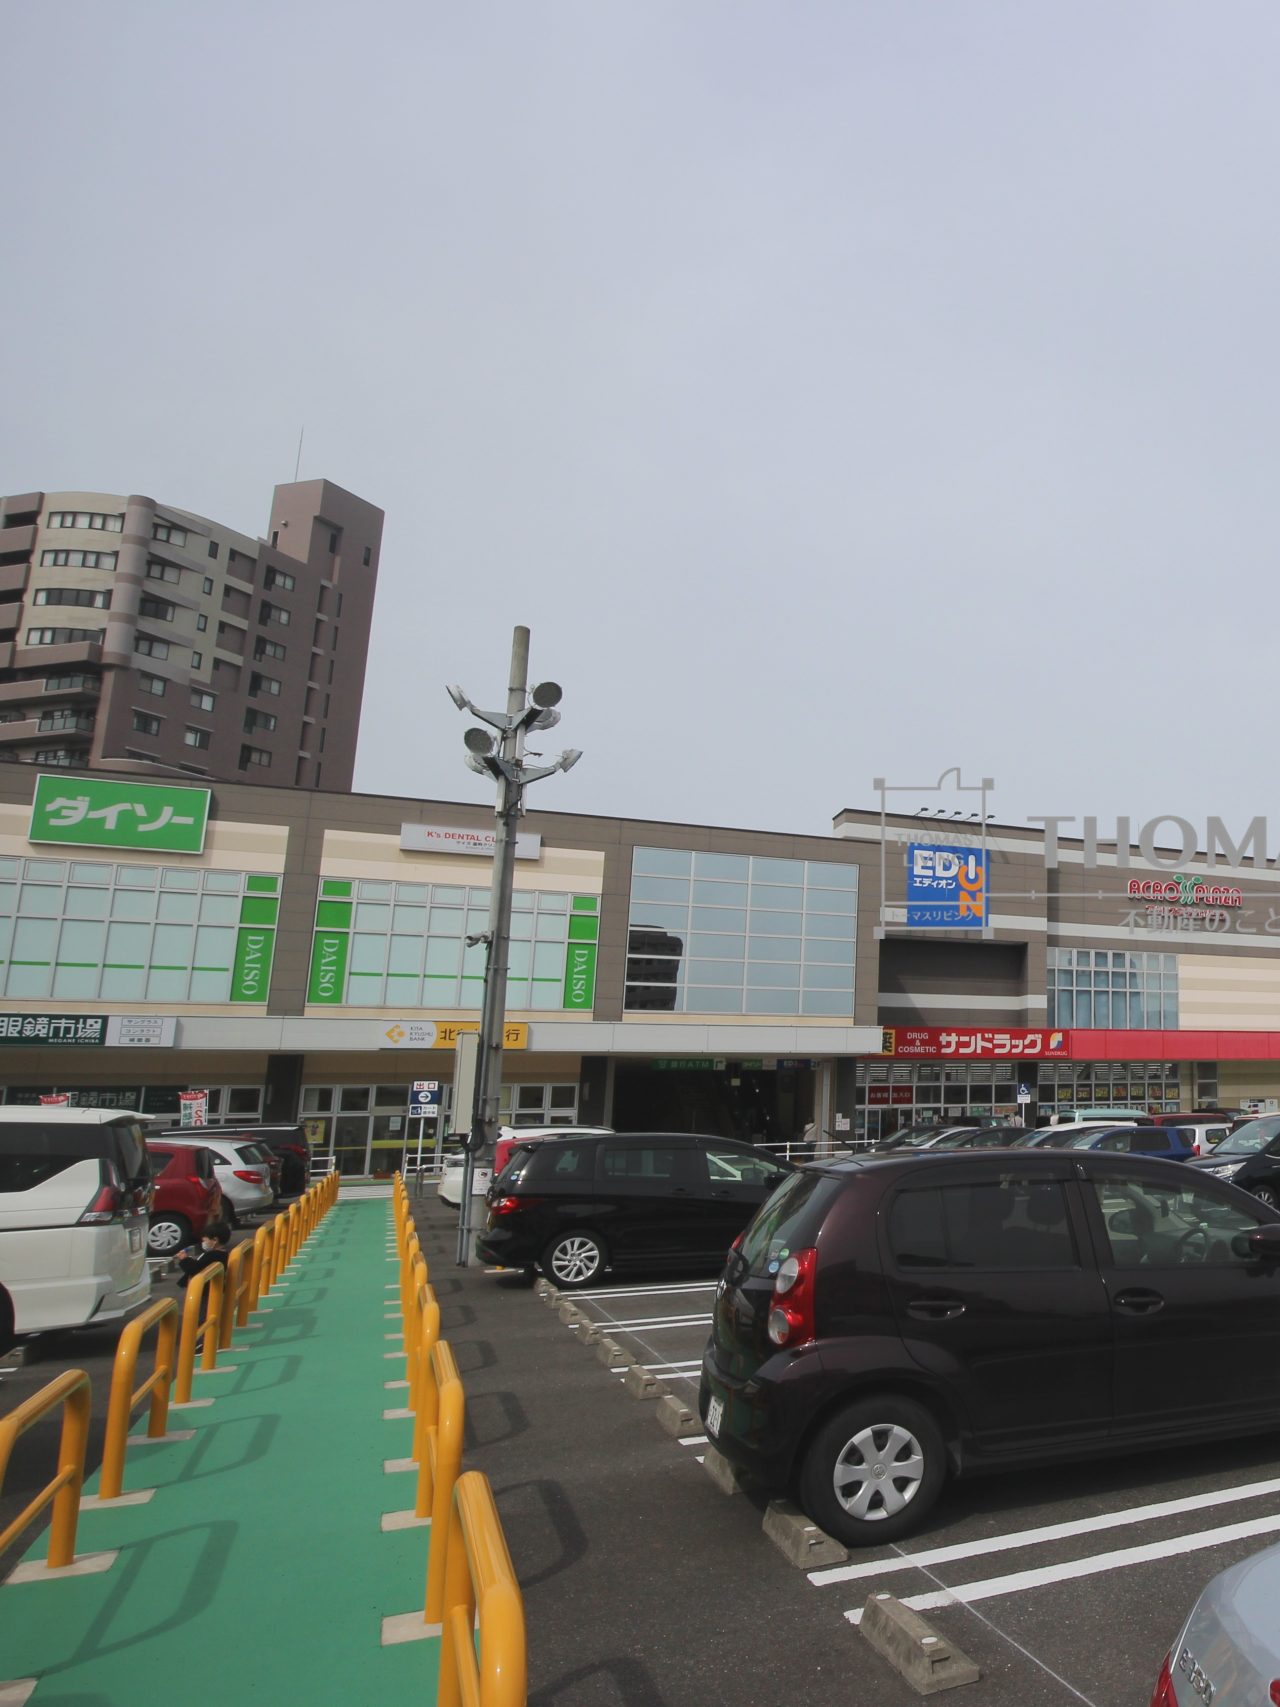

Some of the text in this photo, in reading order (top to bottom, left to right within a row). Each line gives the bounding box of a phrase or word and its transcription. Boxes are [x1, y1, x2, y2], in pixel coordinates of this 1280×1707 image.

[45, 796, 194, 832] ダイソー
[444, 833, 481, 842] DENTAL
[913, 877, 956, 888] エディオン
[1128, 874, 1242, 906] ACROSS PLAZA
[241, 936, 264, 995] DAISO
[318, 939, 339, 997] DAISO
[572, 950, 588, 1003] DAISO
[939, 1032, 1042, 1054] サンドラッグ
